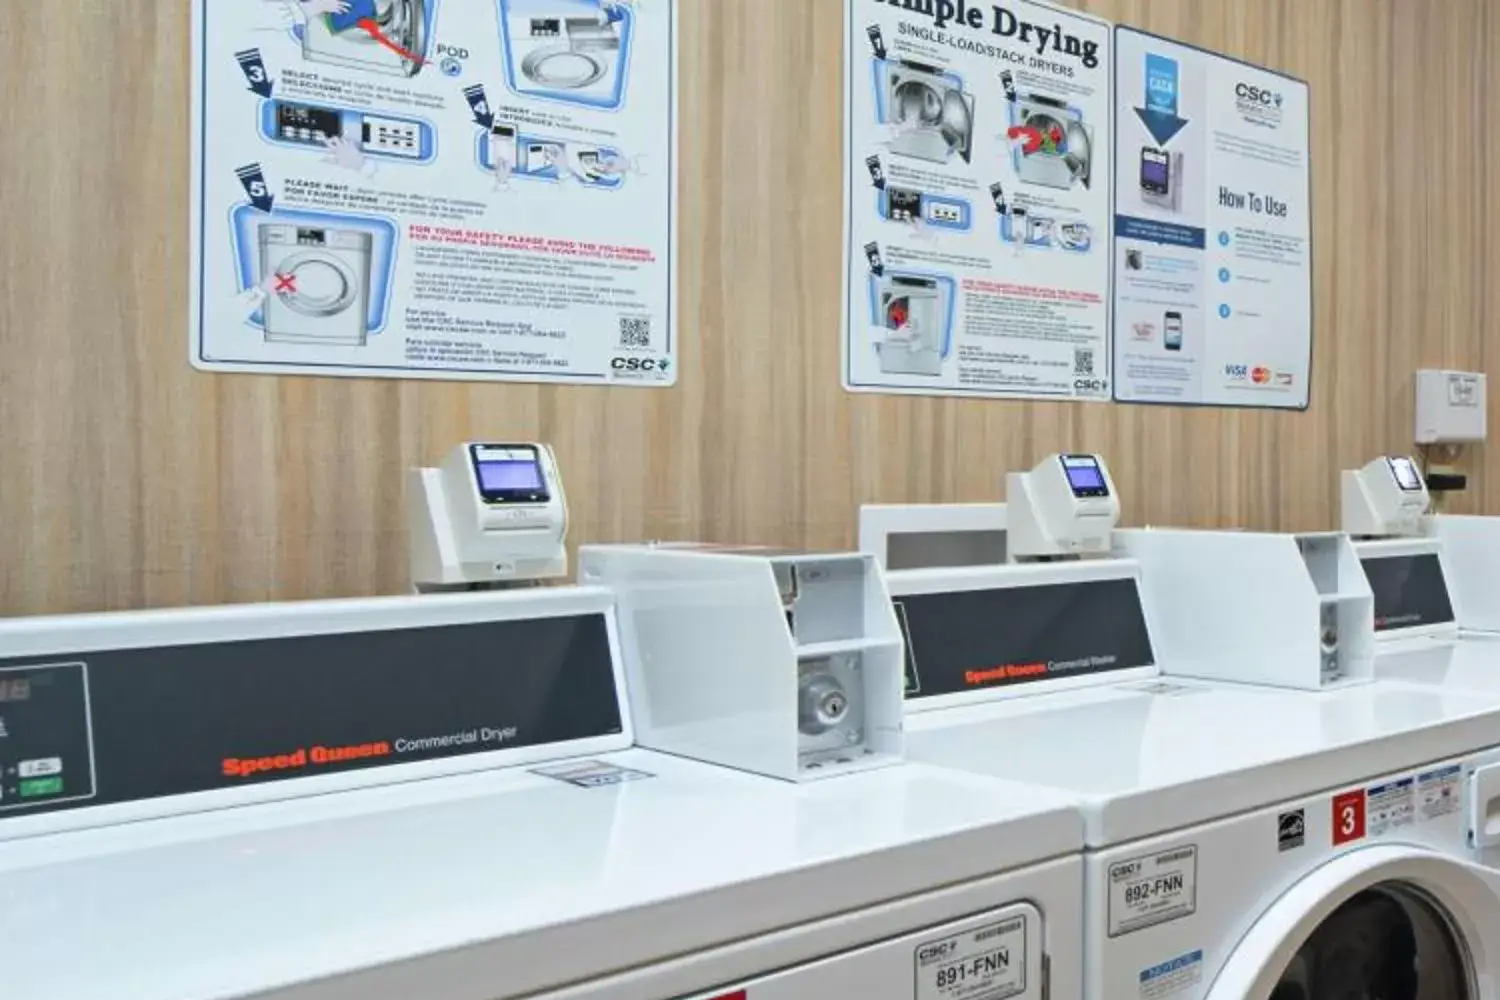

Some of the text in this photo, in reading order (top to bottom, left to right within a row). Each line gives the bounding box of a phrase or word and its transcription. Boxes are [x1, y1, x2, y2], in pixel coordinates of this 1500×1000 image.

[874, 0, 983, 28] mple
[991, 4, 1099, 68] Drying
[437, 43, 469, 59] POD
[249, 66, 264, 83] 3
[1029, 56, 1075, 79] DRYERS
[1235, 82, 1273, 105] CSC
[250, 180, 266, 197] 5
[284, 178, 321, 190] PLEASE
[324, 183, 349, 192] WAIT
[284, 187, 378, 204] POR FAVOR ESPERE
[1218, 185, 1288, 218] How To Use
[410, 224, 430, 234] FOR
[433, 227, 463, 236] YOUR
[465, 230, 504, 241] SAFETY
[507, 234, 544, 245] PLEASE
[610, 357, 655, 371] CSC
[1225, 363, 1248, 377] VISA
[1073, 379, 1100, 390] CSC
[221, 725, 518, 776] Speed Queen Commercial Dryer
[1341, 806, 1356, 836] 3
[1125, 874, 1185, 903] 892-FNN
[936, 949, 1010, 988] 891-FNN
